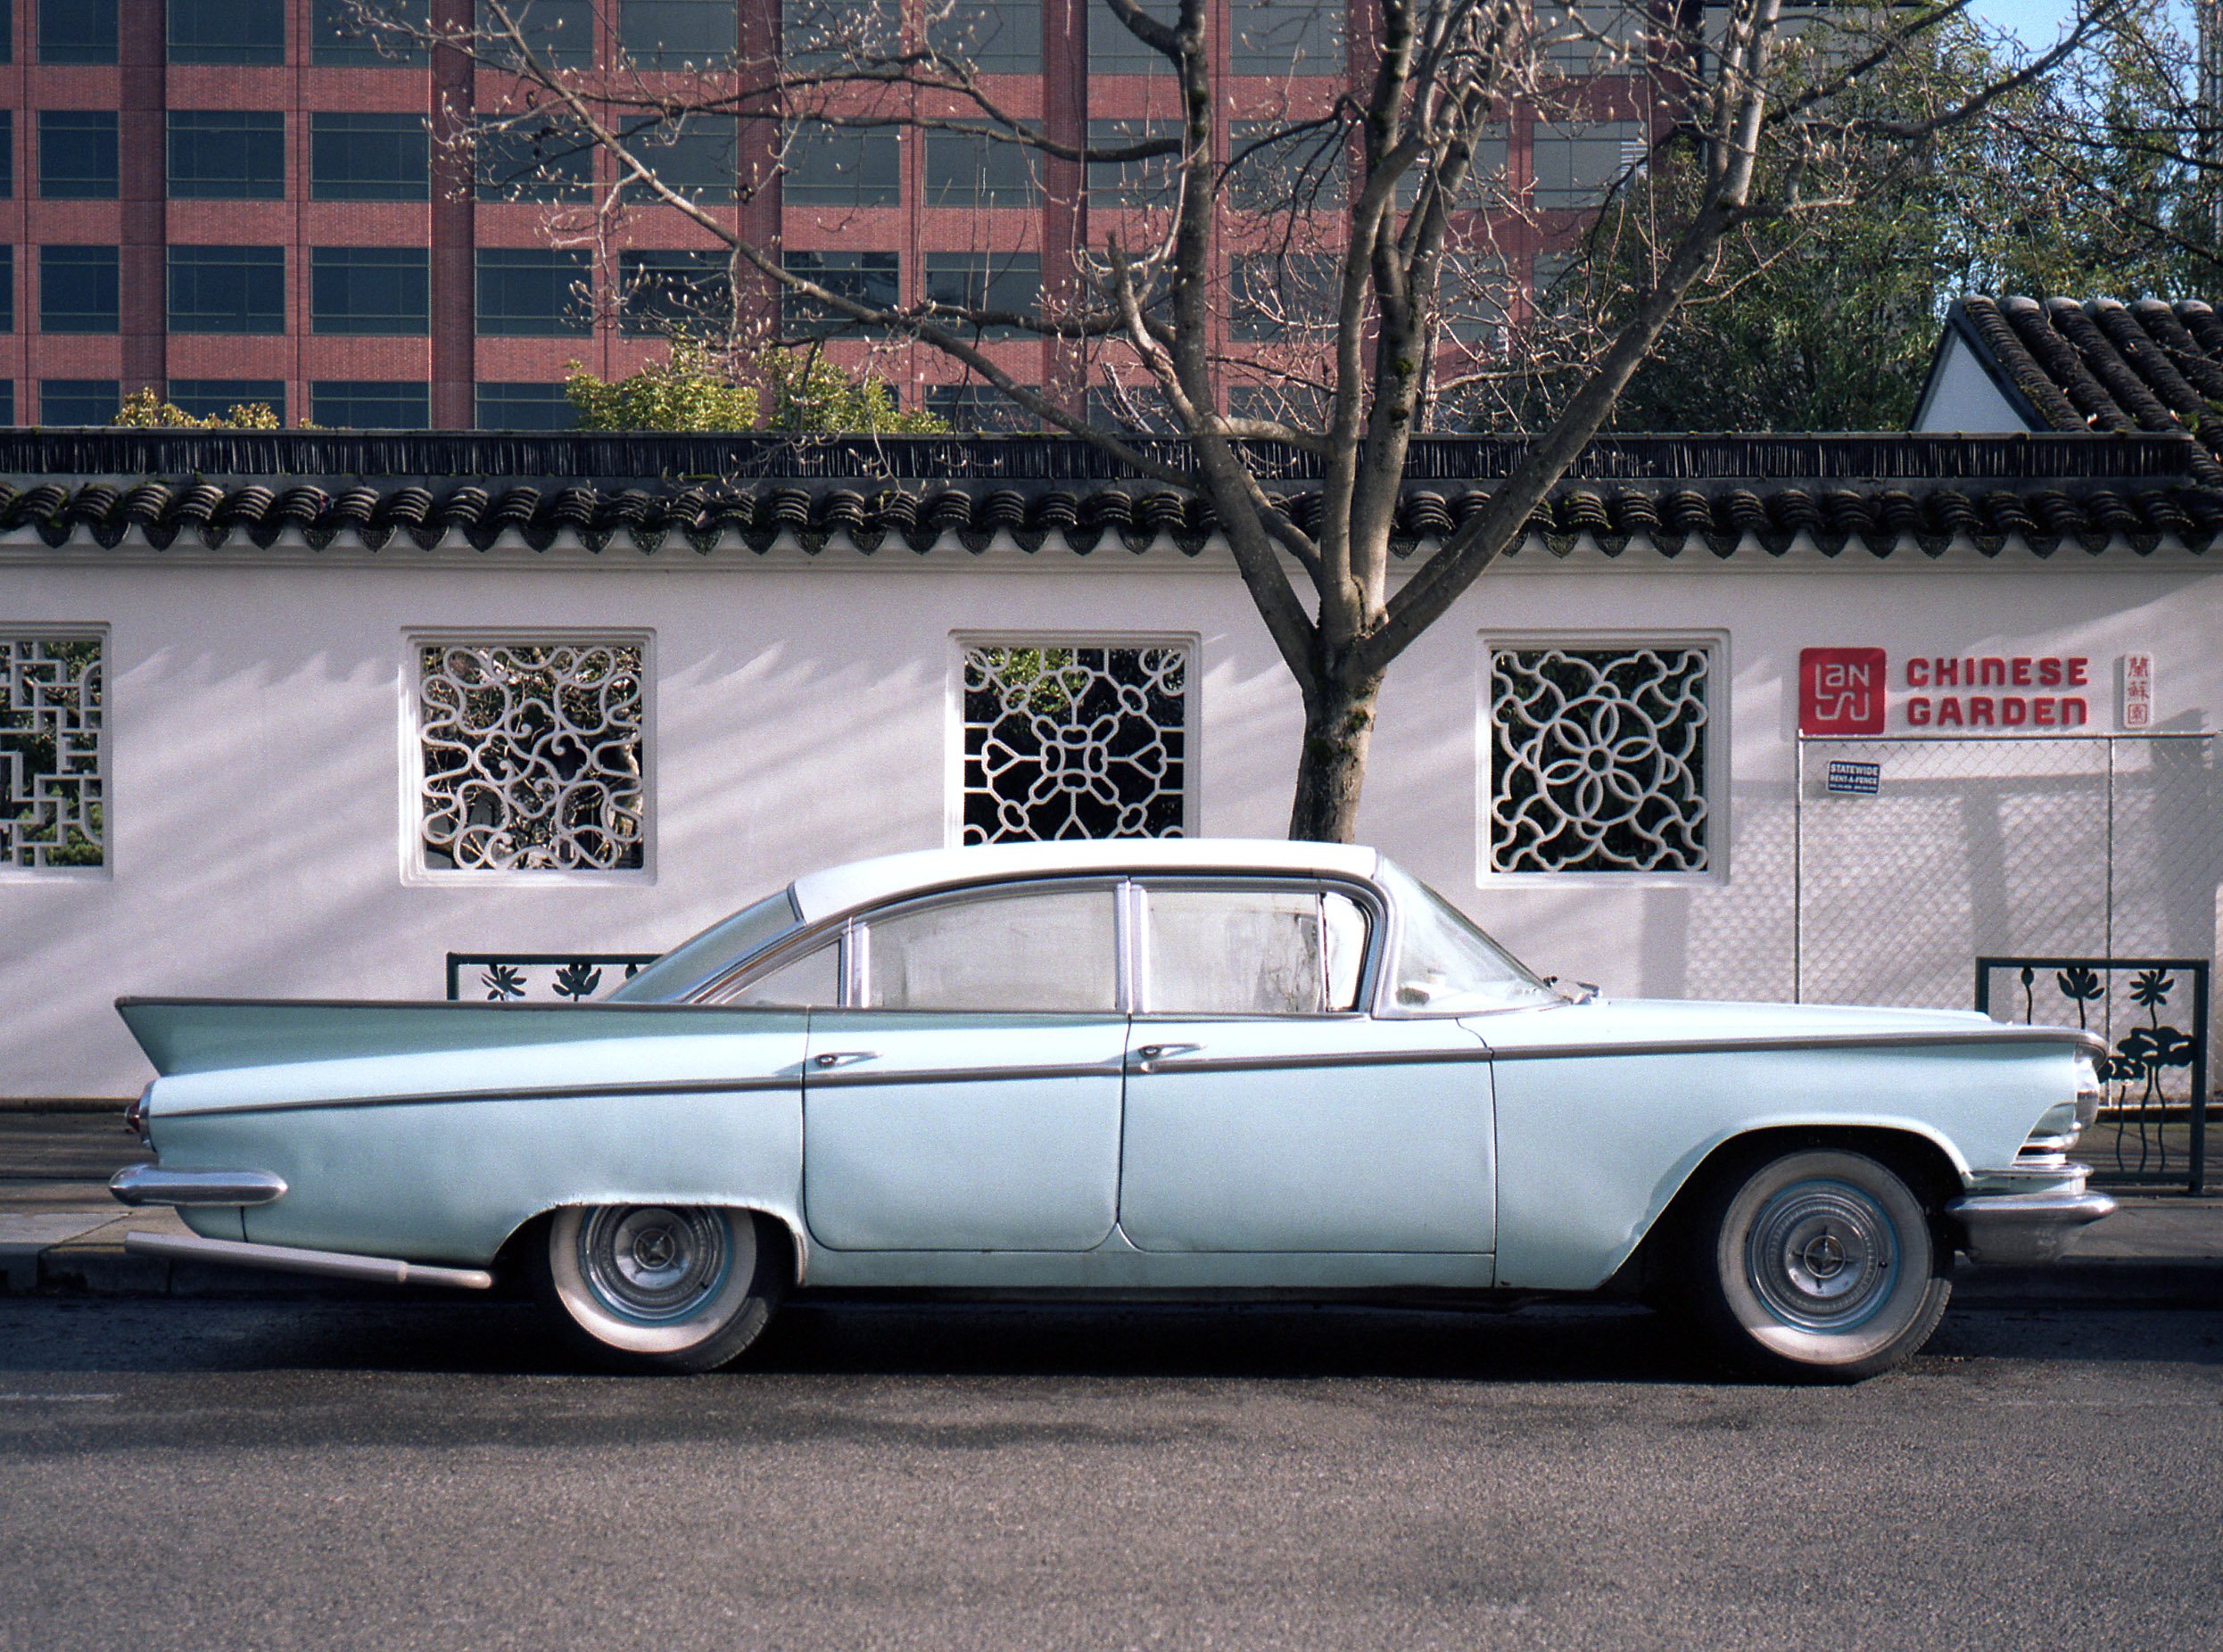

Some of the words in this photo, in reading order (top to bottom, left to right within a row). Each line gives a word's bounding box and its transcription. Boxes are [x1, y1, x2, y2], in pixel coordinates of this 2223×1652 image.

[1907, 657, 2088, 686] CHINESE
[1907, 696, 2087, 725] GARDEN
[1830, 764, 1878, 776] STATEWIDE
